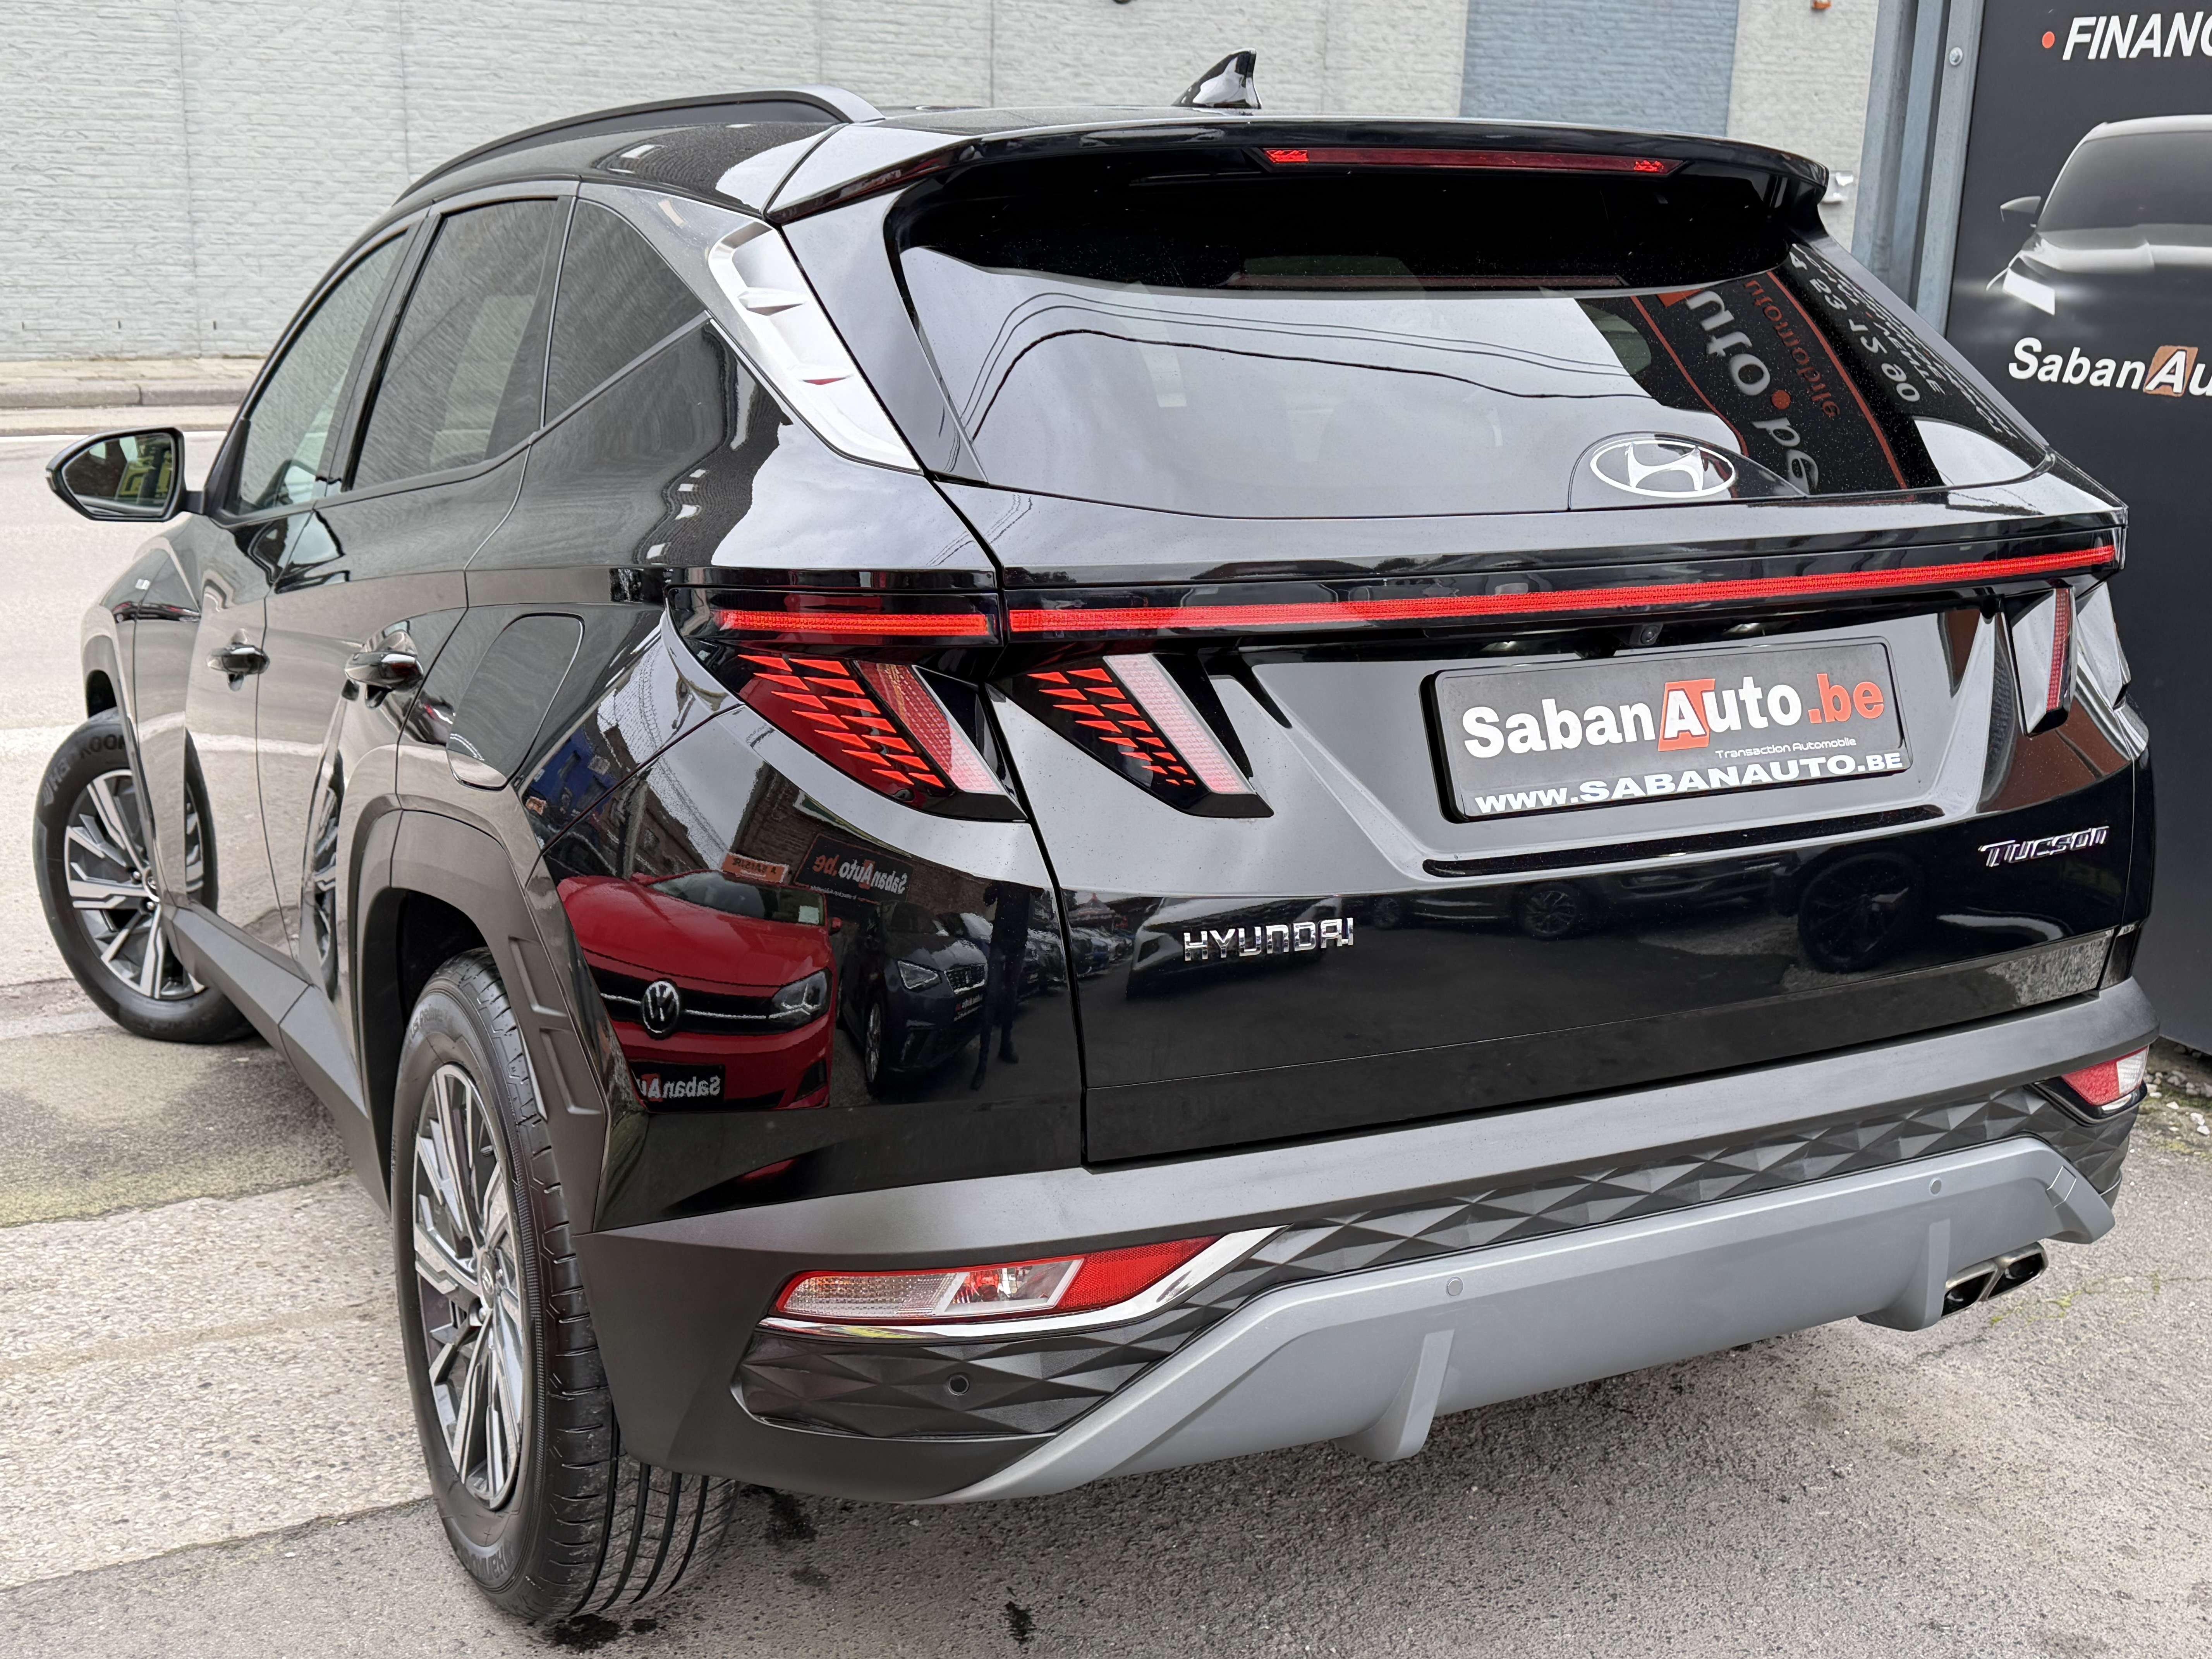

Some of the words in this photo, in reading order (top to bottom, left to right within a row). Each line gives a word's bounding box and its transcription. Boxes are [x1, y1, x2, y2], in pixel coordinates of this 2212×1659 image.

[1462, 673, 1885, 758] SabanAuto.be
[1715, 744, 1791, 759] Transaction
[1793, 737, 1857, 751] Automobile
[1183, 917, 1354, 961] HYUNDAI
